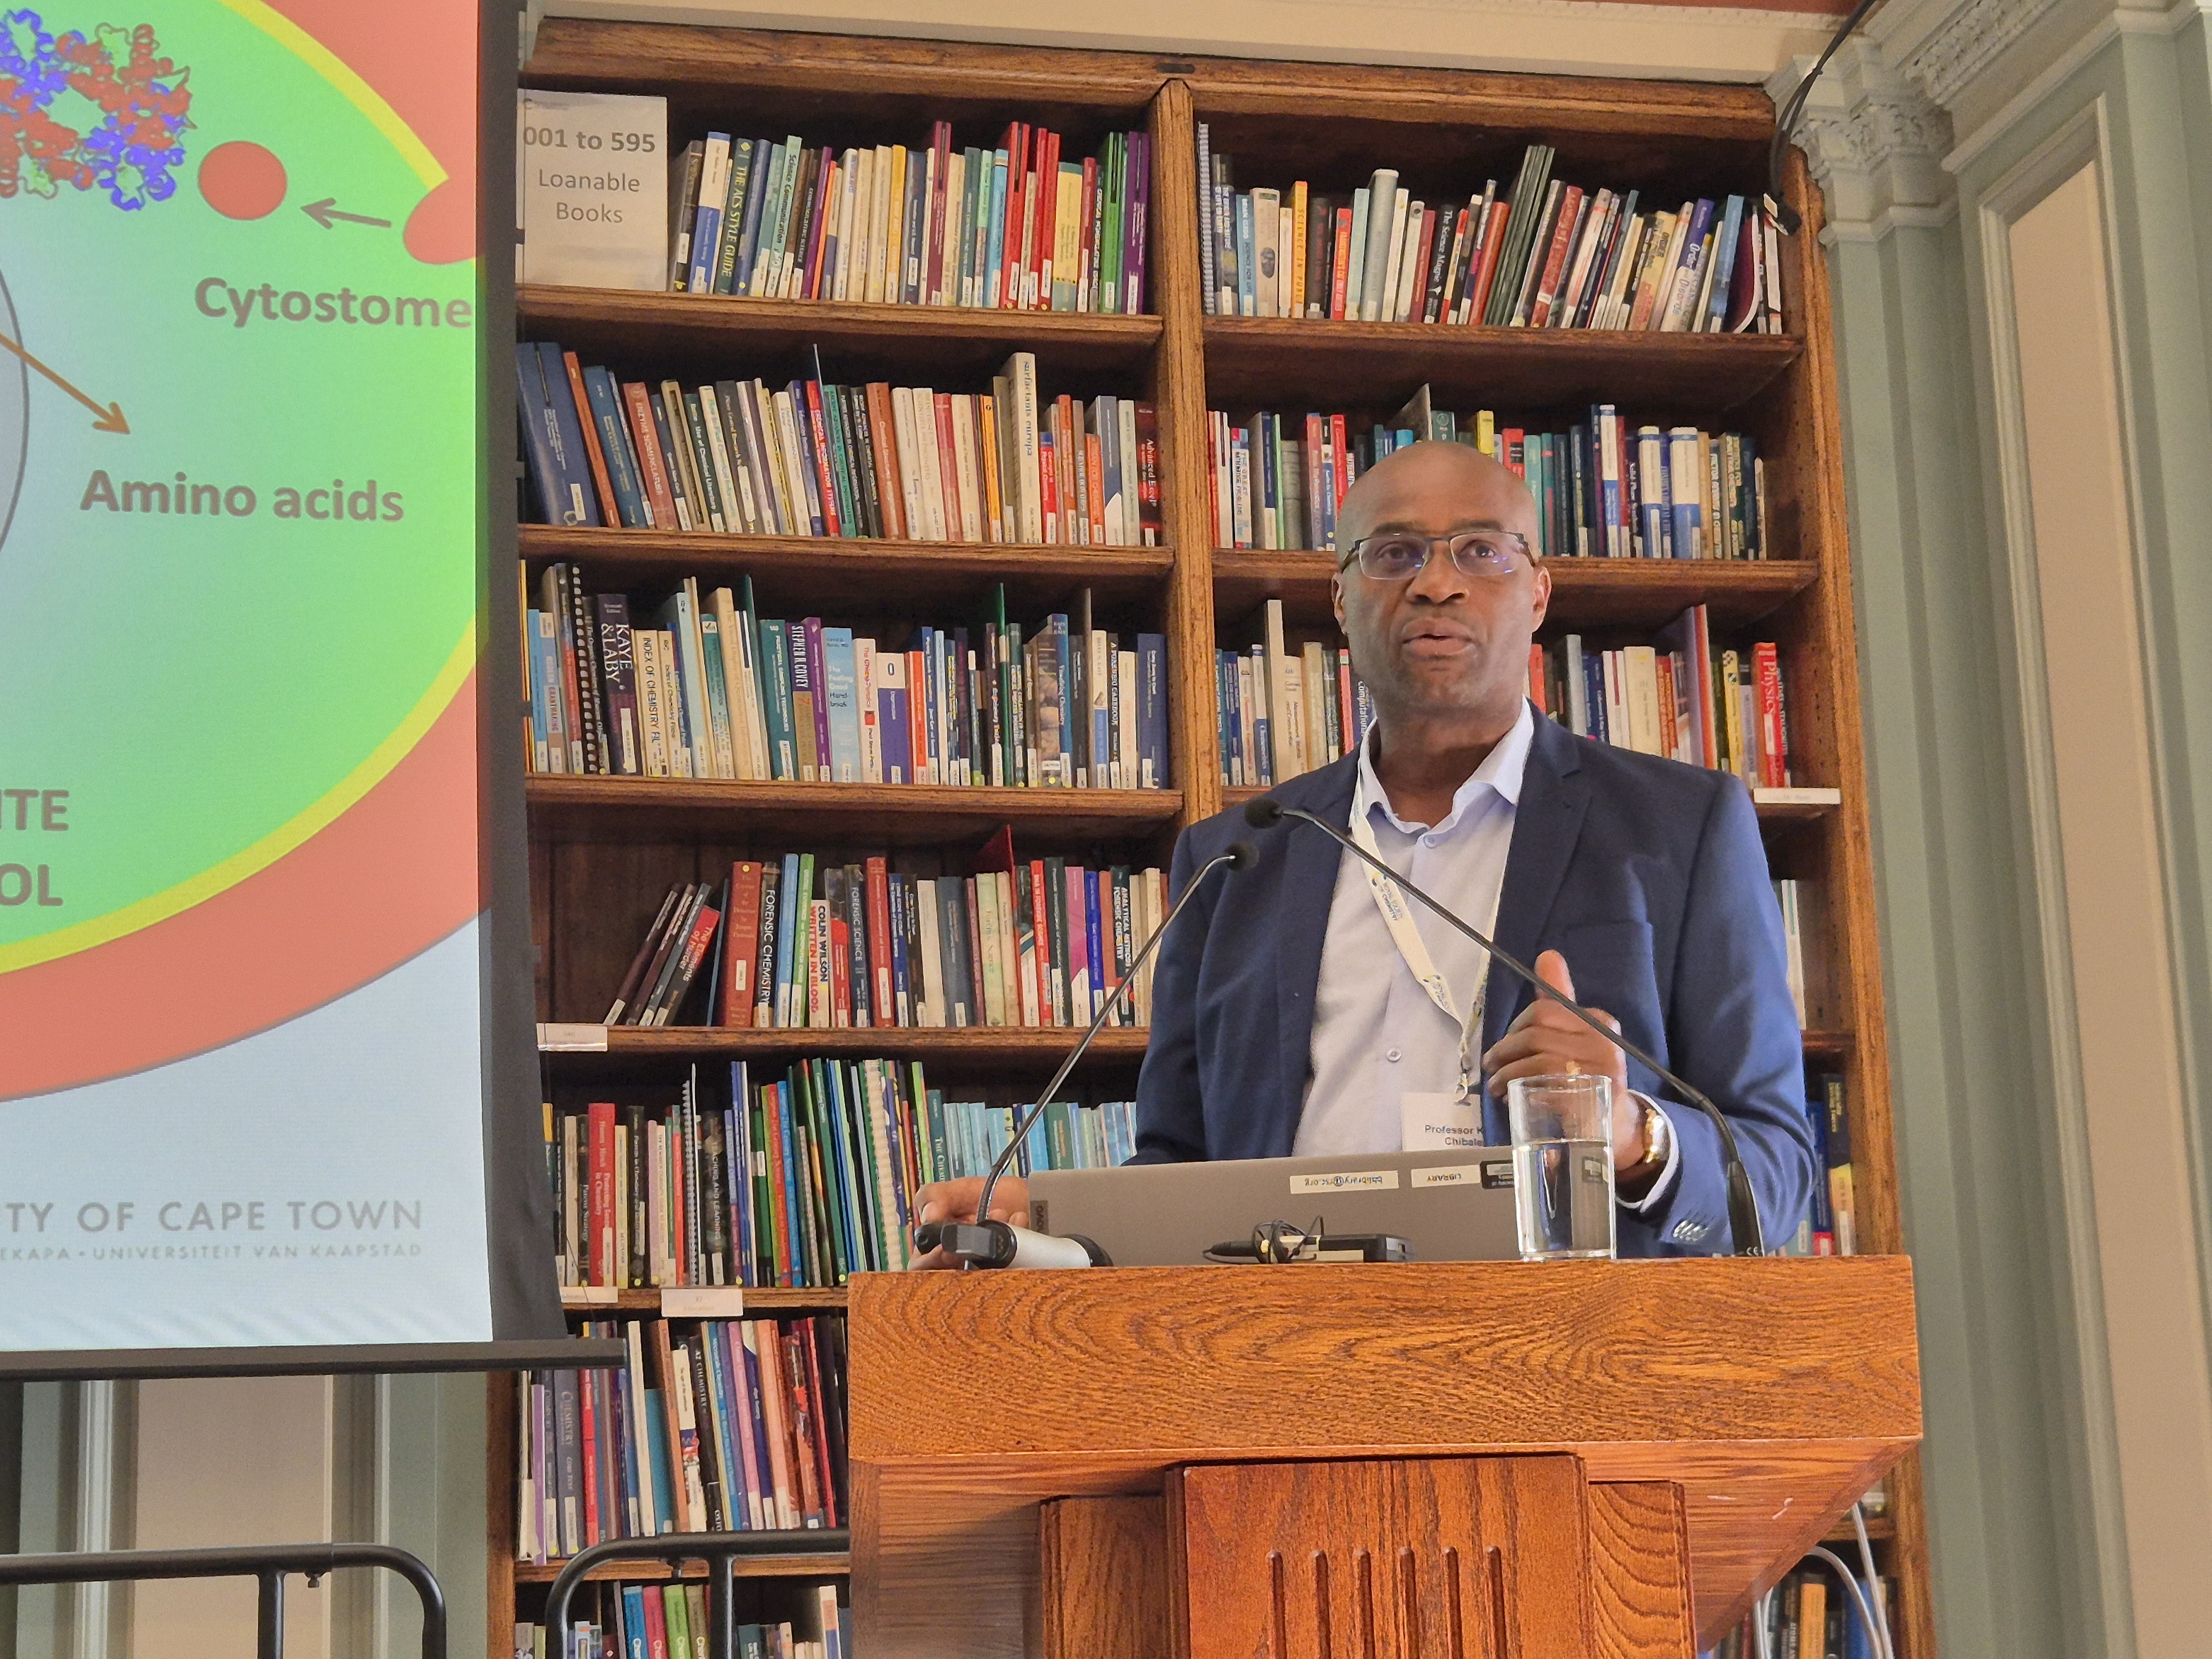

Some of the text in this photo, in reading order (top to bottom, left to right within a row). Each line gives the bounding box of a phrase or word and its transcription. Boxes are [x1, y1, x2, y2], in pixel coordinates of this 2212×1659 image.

[523, 126, 656, 153] 001 to 595
[539, 169, 640, 192] Loanable
[776, 154, 796, 244] Science Communication
[556, 202, 623, 223] Books
[721, 166, 747, 277] THE ACS STYLE GUIDE
[1297, 258, 1302, 267] IN
[1432, 210, 1453, 283] The Science Magpie
[1670, 243, 1700, 315] Order Disorde
[195, 277, 472, 327] Cytostome
[1024, 420, 1034, 455] europa
[1145, 439, 1156, 477] Advanced
[80, 469, 404, 522] Amino acids
[615, 623, 632, 670] KAYE
[791, 625, 805, 655] STEPHEN
[643, 637, 660, 743] INDEX OF CHEMISTRY FIL
[794, 664, 808, 688] COVEY
[1761, 661, 1777, 714] Physics
[548, 687, 558, 731] GRANTMAKING
[1058, 696, 1066, 726] Chemistry
[0, 788, 70, 832] TE
[0, 863, 64, 907] OL
[852, 887, 862, 961] FORENSIC SCIENCE
[1121, 887, 1129, 931] ANALYTICAL
[678, 929, 700, 971] of Murder
[682, 925, 713, 982] The Elements
[760, 890, 775, 1003] FORENSIC CHEMISTRY
[810, 962, 817, 972] IN
[819, 940, 827, 981] WILSON
[1425, 1124, 1474, 1134] Professor
[1444, 1136, 1482, 1146] Chibale
[594, 1180, 602, 1215] Chemistry
[1427, 1173, 1462, 1182] LIBRARY
[6, 1201, 421, 1232] TY OF CAPE TOWN
[92, 1245, 243, 1260] UNIVERSITEIT
[253, 1244, 298, 1259] VAN
[310, 1243, 422, 1259] KAAPSTAD
[696, 1362, 707, 1406] CHEMISTRY
[561, 1391, 575, 1446] CHEMISTRY
